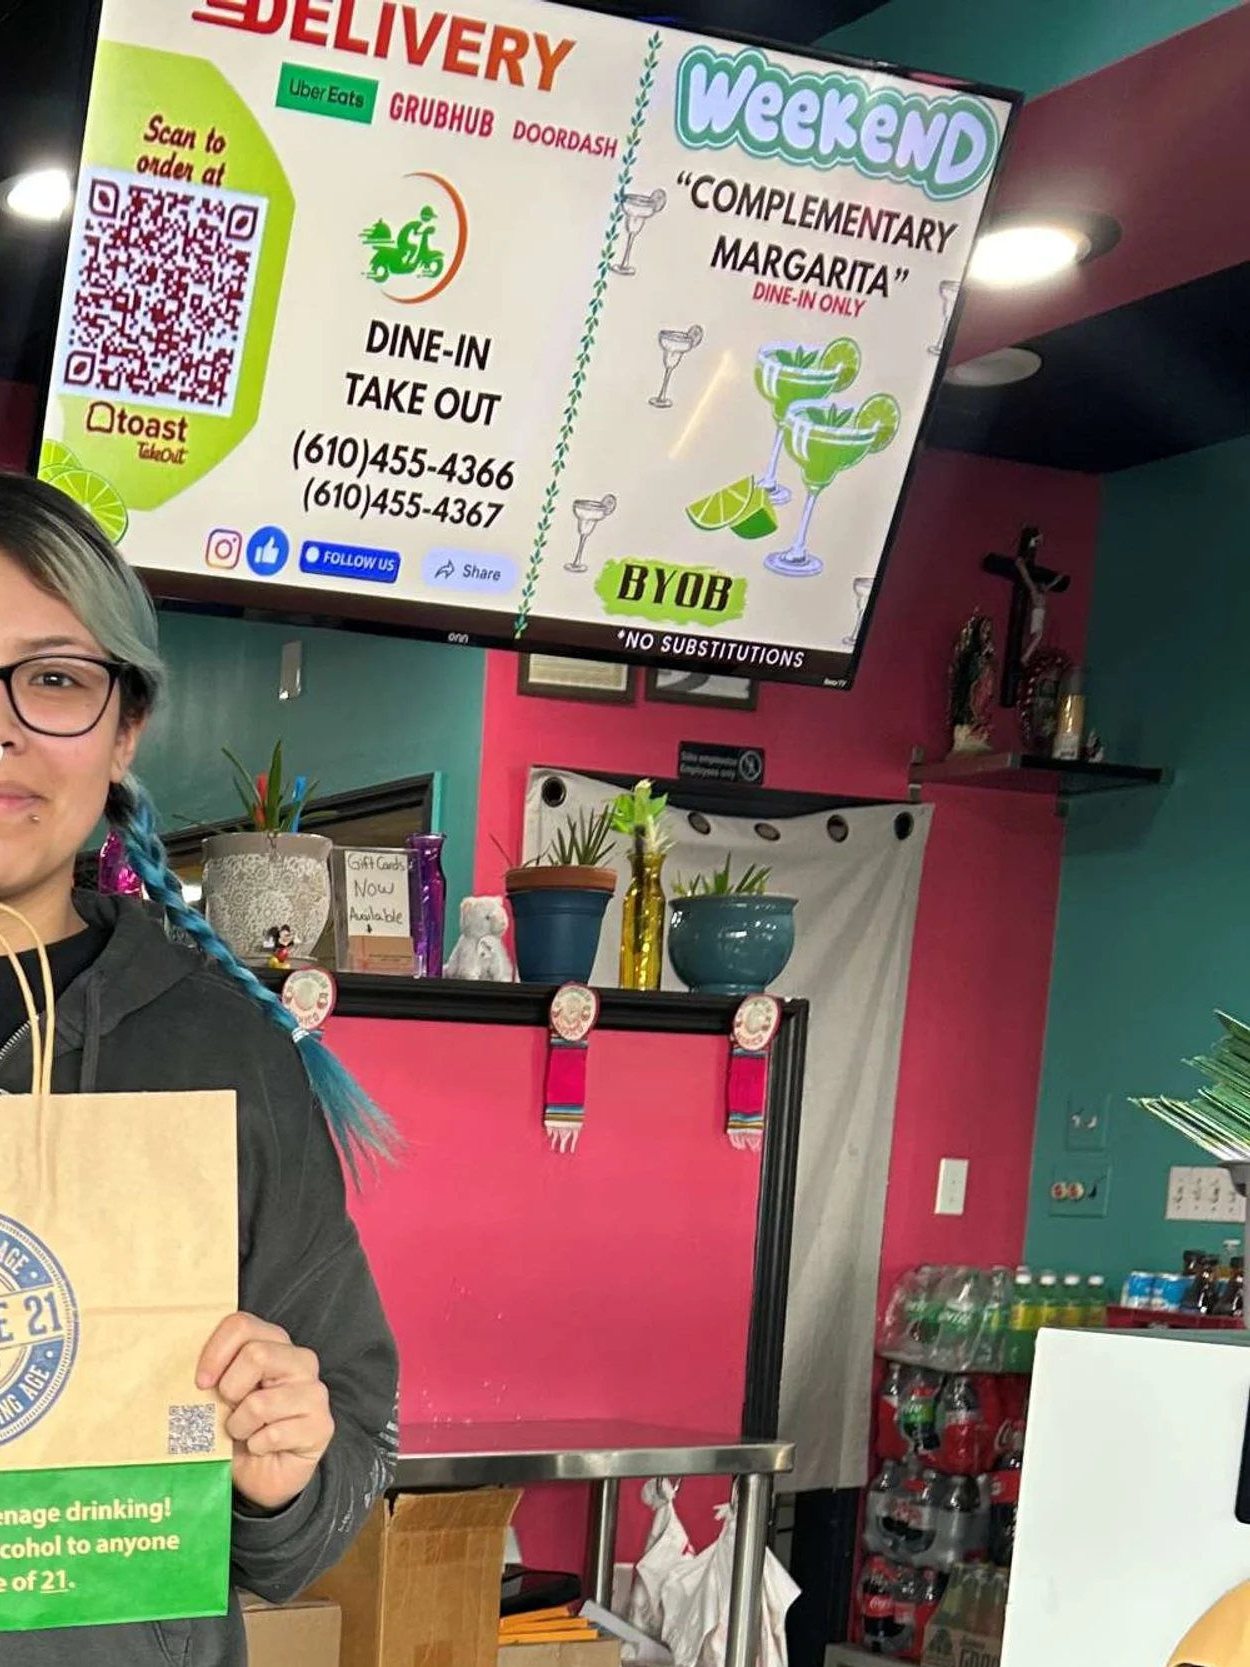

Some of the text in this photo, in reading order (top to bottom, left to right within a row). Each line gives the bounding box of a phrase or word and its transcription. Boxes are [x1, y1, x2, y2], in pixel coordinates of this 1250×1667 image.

[244, 0, 577, 92] DELIVERY
[289, 78, 364, 109] Uber Eats
[143, 113, 226, 154] Scan to
[388, 92, 494, 138] GRUBHUB
[512, 120, 618, 159] DOORDASH
[136, 151, 226, 188] order at
[752, 281, 866, 318] DINE-IN ONLY
[365, 319, 491, 371] DINE-IN
[345, 372, 502, 426] TAKE OUT
[117, 407, 188, 443] toast
[293, 429, 515, 491] (610)455-4366
[303, 476, 504, 529] (610)455-4367
[323, 550, 395, 571] FOLLOW US
[462, 563, 501, 582] Share
[617, 563, 734, 612] BYOB
[661, 638, 805, 668] SUBSTITUTIONS
[348, 853, 406, 872] Gift Cards
[349, 905, 403, 924] Available
[23, 1291, 63, 1337] 21
[18, 1363, 50, 1401] AGE
[65, 1496, 172, 1523] drinking!
[66, 1536, 91, 1555] to
[96, 1534, 180, 1557] anyone
[11, 1570, 37, 1592] of
[40, 1569, 76, 1594] 21.
